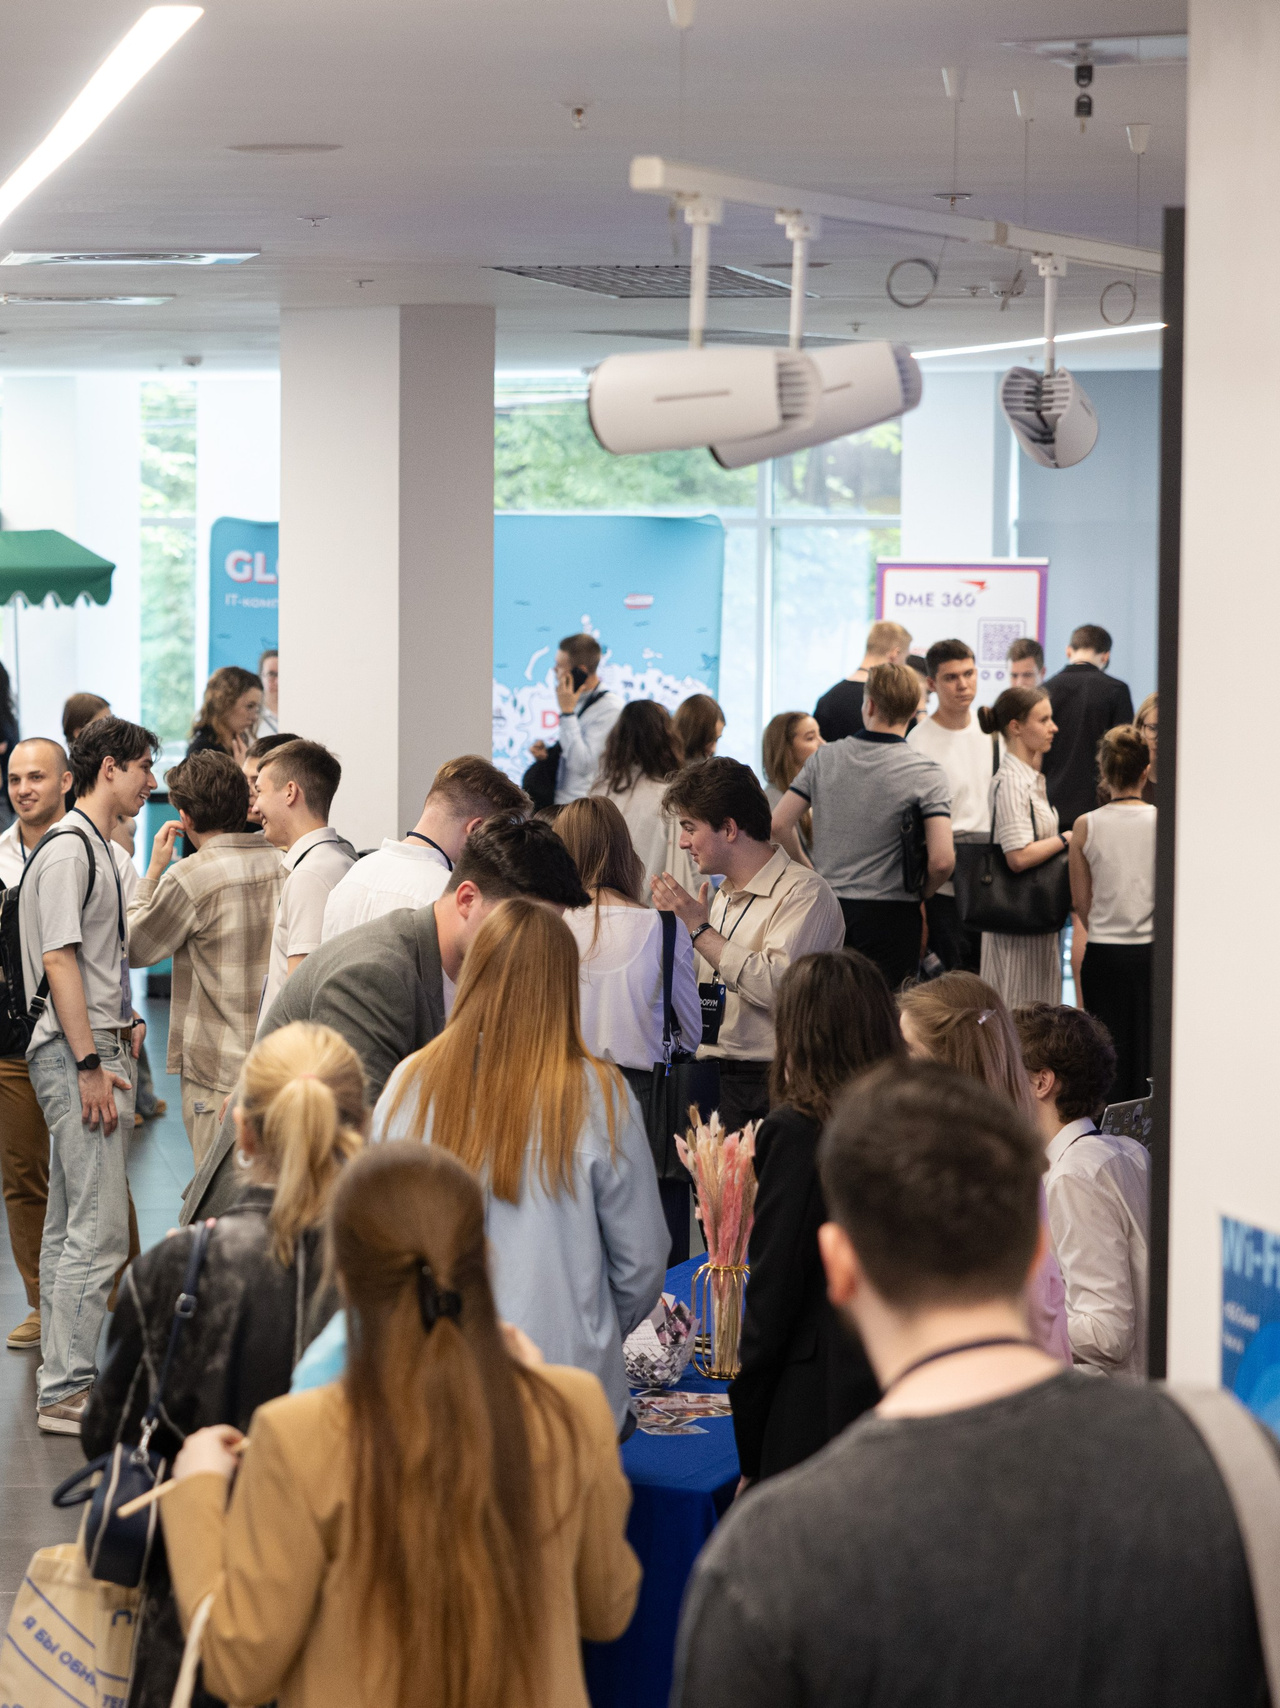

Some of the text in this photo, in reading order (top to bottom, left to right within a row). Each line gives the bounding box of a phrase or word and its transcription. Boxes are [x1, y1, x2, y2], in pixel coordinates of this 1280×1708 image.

[225, 550, 278, 584] GL
[895, 592, 976, 607] DME 360
[23, 1615, 37, 1630] Я
[34, 1628, 60, 1655] БЫ
